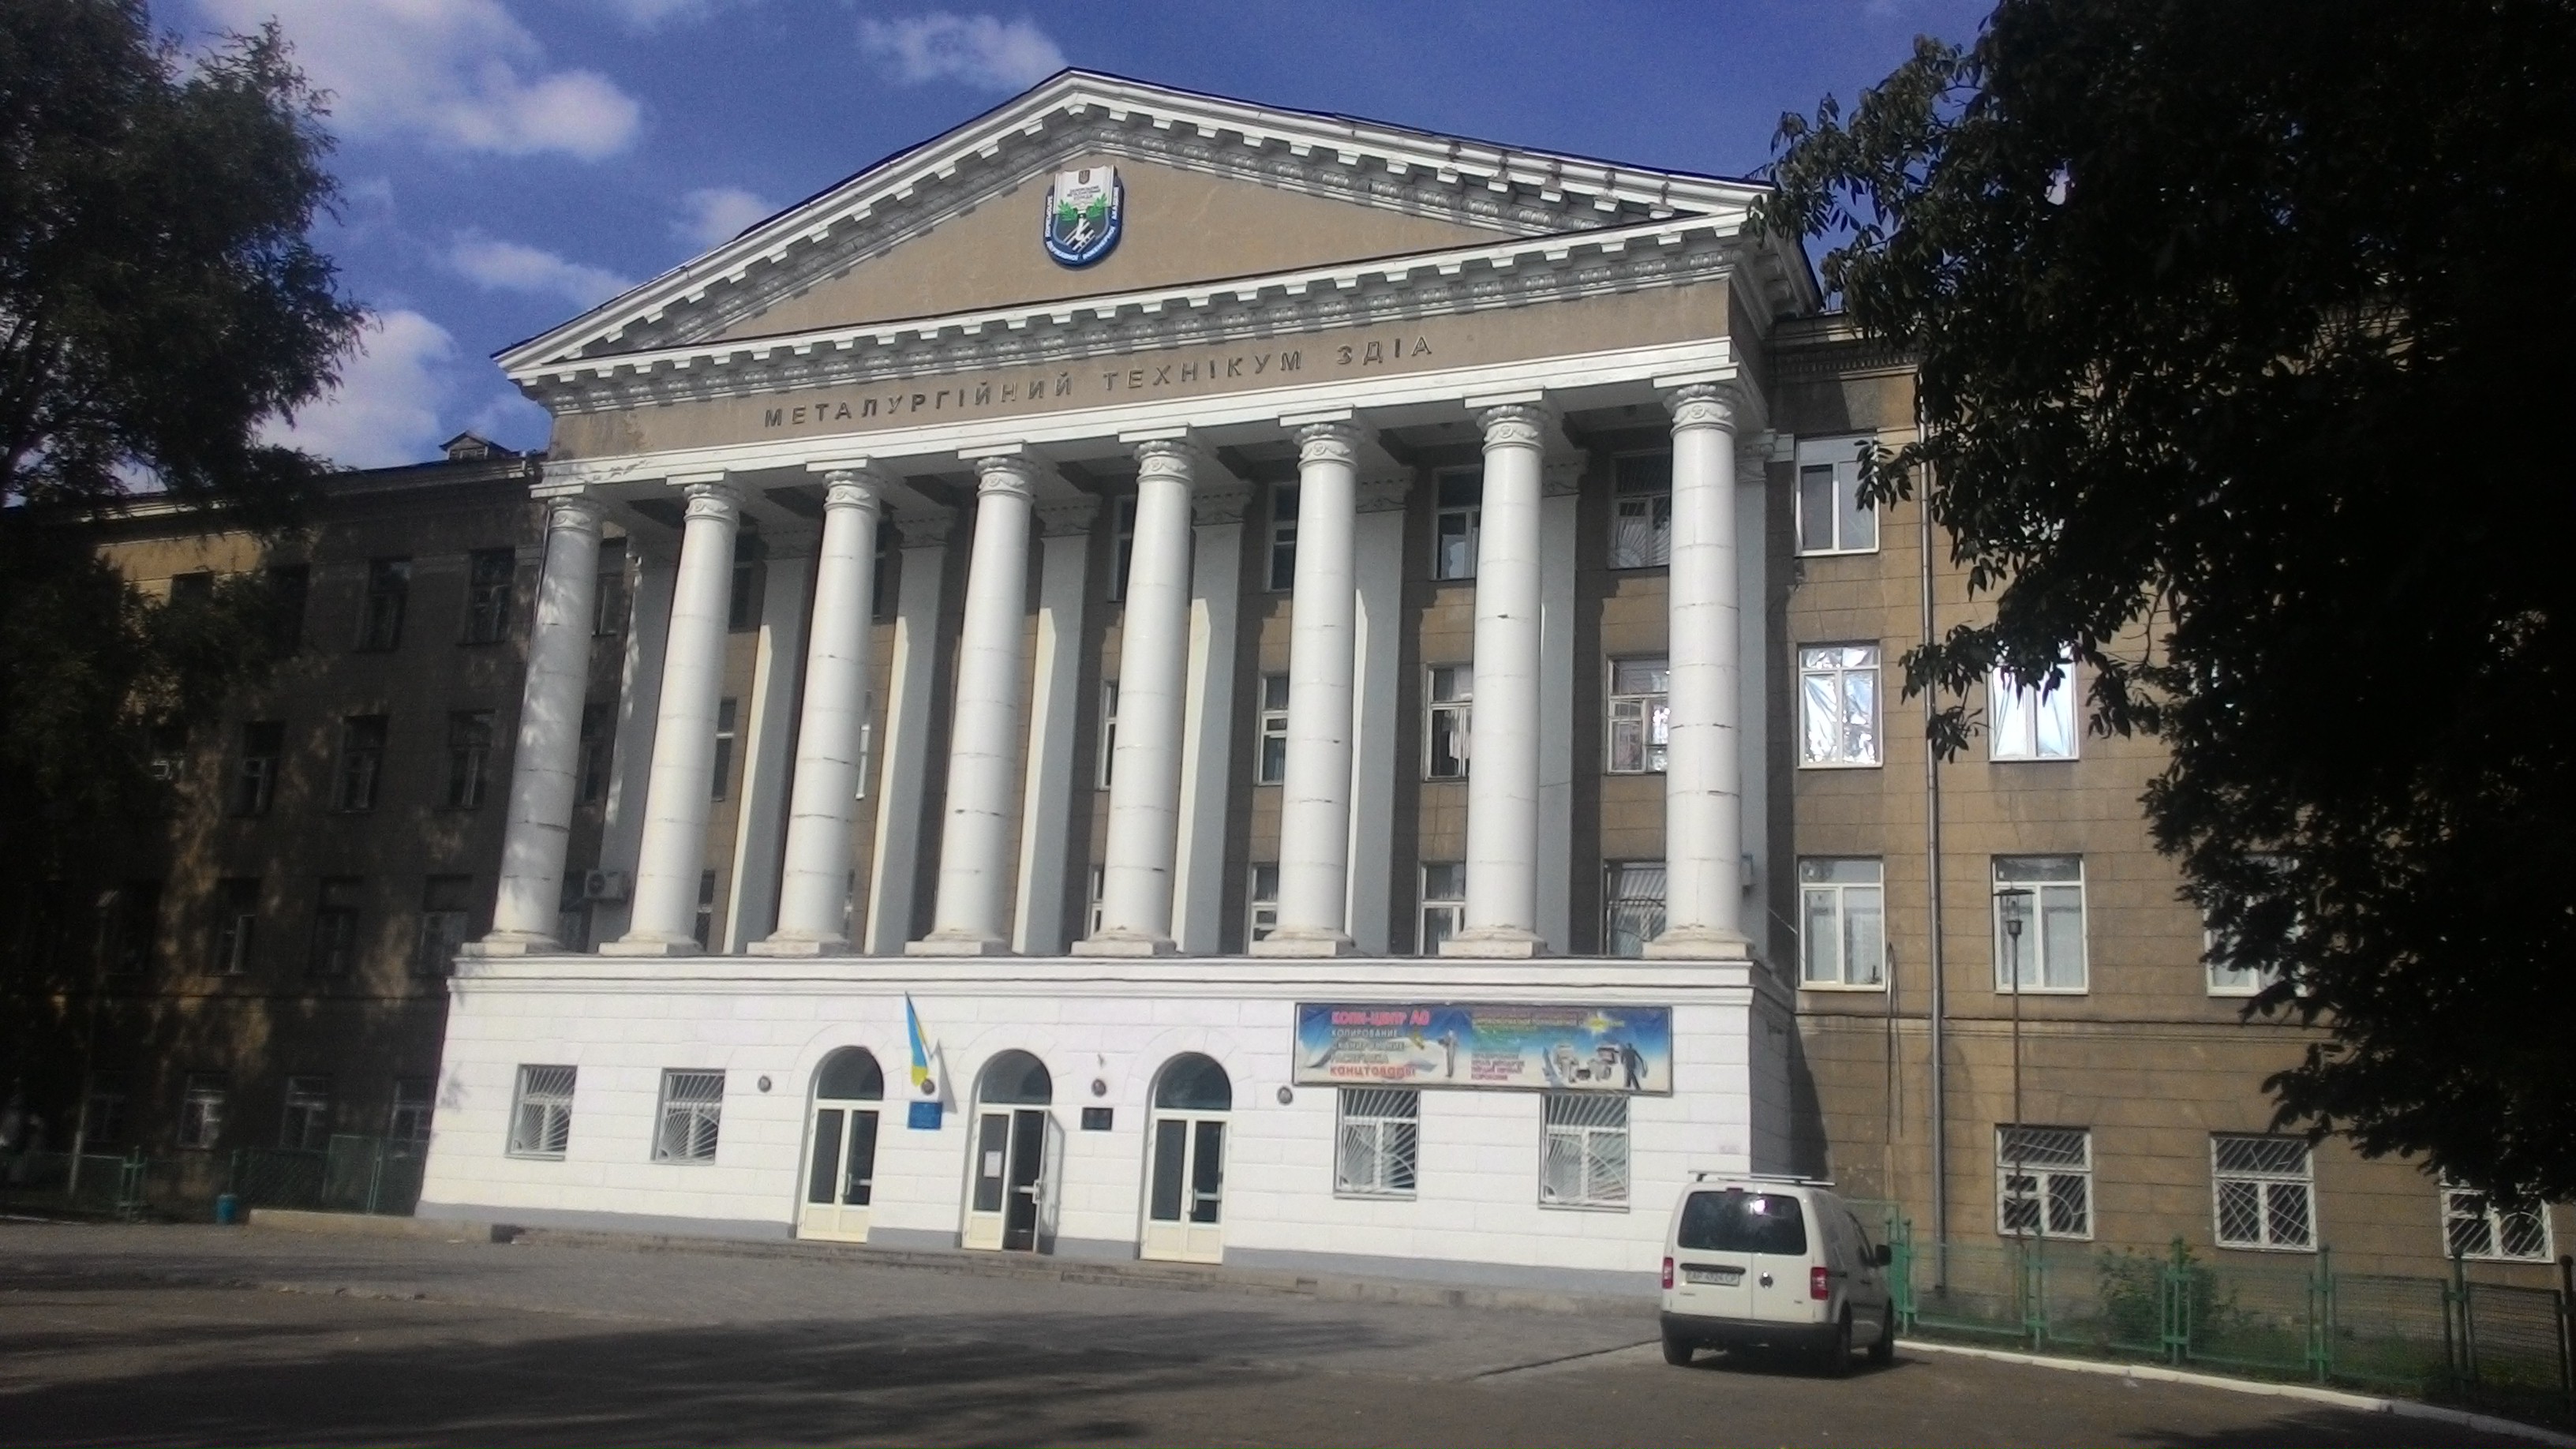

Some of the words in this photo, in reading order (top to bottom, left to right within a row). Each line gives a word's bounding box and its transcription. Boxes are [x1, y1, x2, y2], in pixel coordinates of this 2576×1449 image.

[765, 372, 1073, 427] МЕТАЛУРГІЙНИЙ
[1103, 350, 1302, 391] ТЕХНІКУМ
[1336, 336, 1432, 365] ЗДІА
